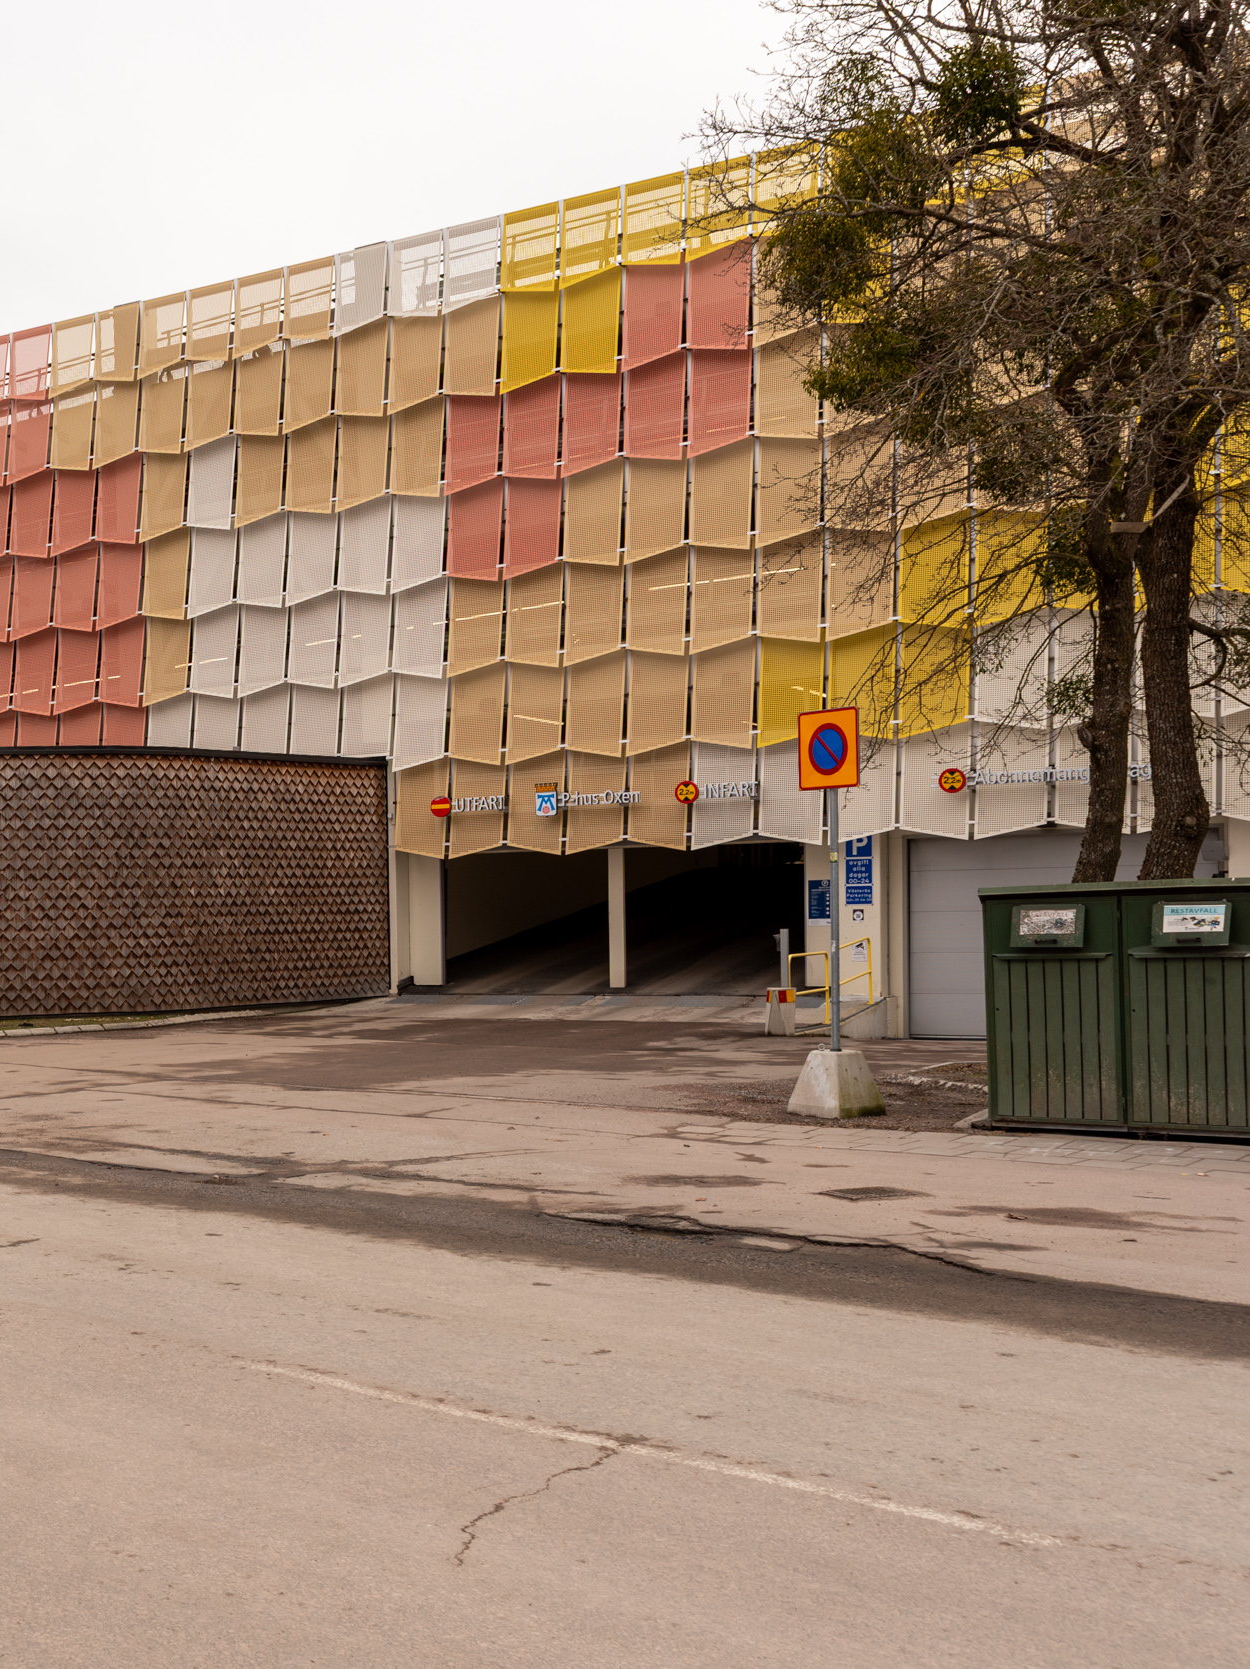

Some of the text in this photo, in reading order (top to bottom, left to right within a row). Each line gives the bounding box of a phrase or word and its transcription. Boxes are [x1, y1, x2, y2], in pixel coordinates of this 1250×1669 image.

[973, 767, 1090, 785] Abonnemang
[560, 790, 639, 805] P-hus Oxen
[678, 788, 694, 796] 2,2m
[704, 781, 758, 798] INFART
[455, 795, 505, 812] UTFART
[852, 837, 868, 855] P
